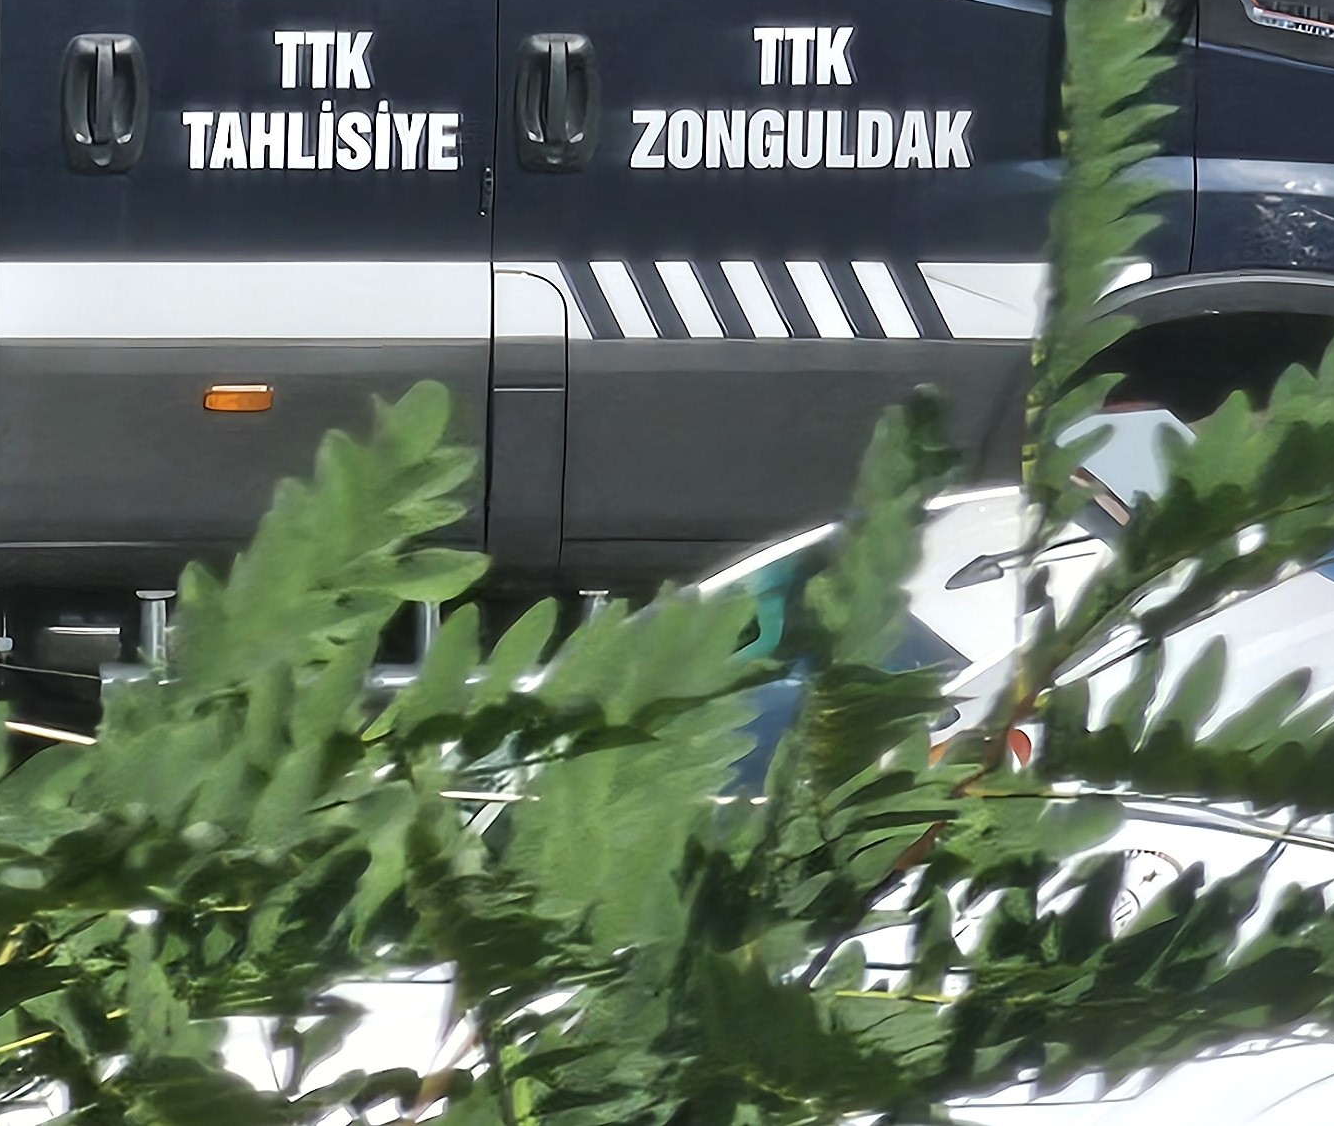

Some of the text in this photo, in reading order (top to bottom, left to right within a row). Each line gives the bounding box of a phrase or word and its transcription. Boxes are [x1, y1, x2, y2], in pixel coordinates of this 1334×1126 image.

[274, 30, 373, 90] TTK
[753, 26, 855, 86] TTK
[181, 99, 461, 171] TAHLİSİYE
[629, 109, 973, 170] ZONGULDAK
